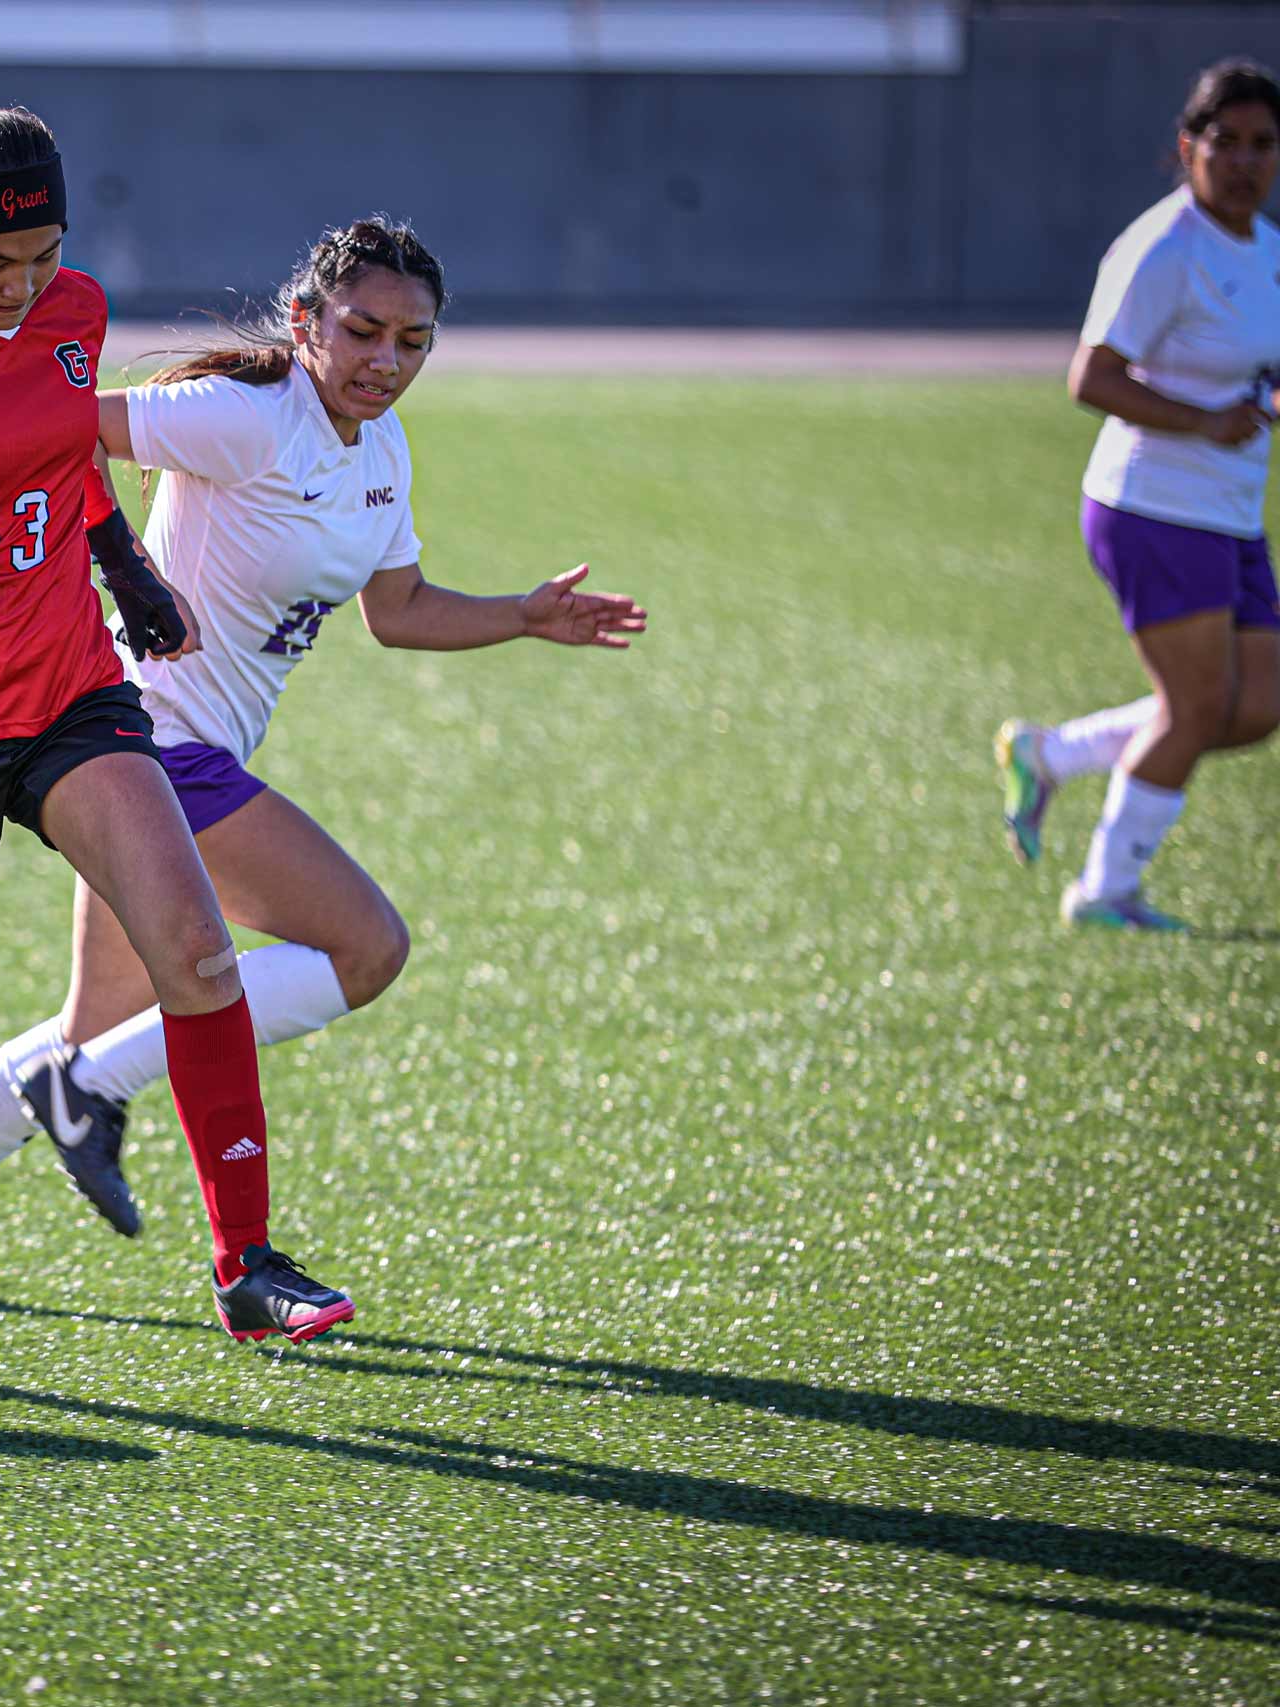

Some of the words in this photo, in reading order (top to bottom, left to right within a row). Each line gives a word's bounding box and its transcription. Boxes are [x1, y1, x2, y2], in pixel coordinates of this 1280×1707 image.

[1, 184, 49, 218] Grant
[54, 341, 89, 388] G
[11, 489, 49, 571] 3
